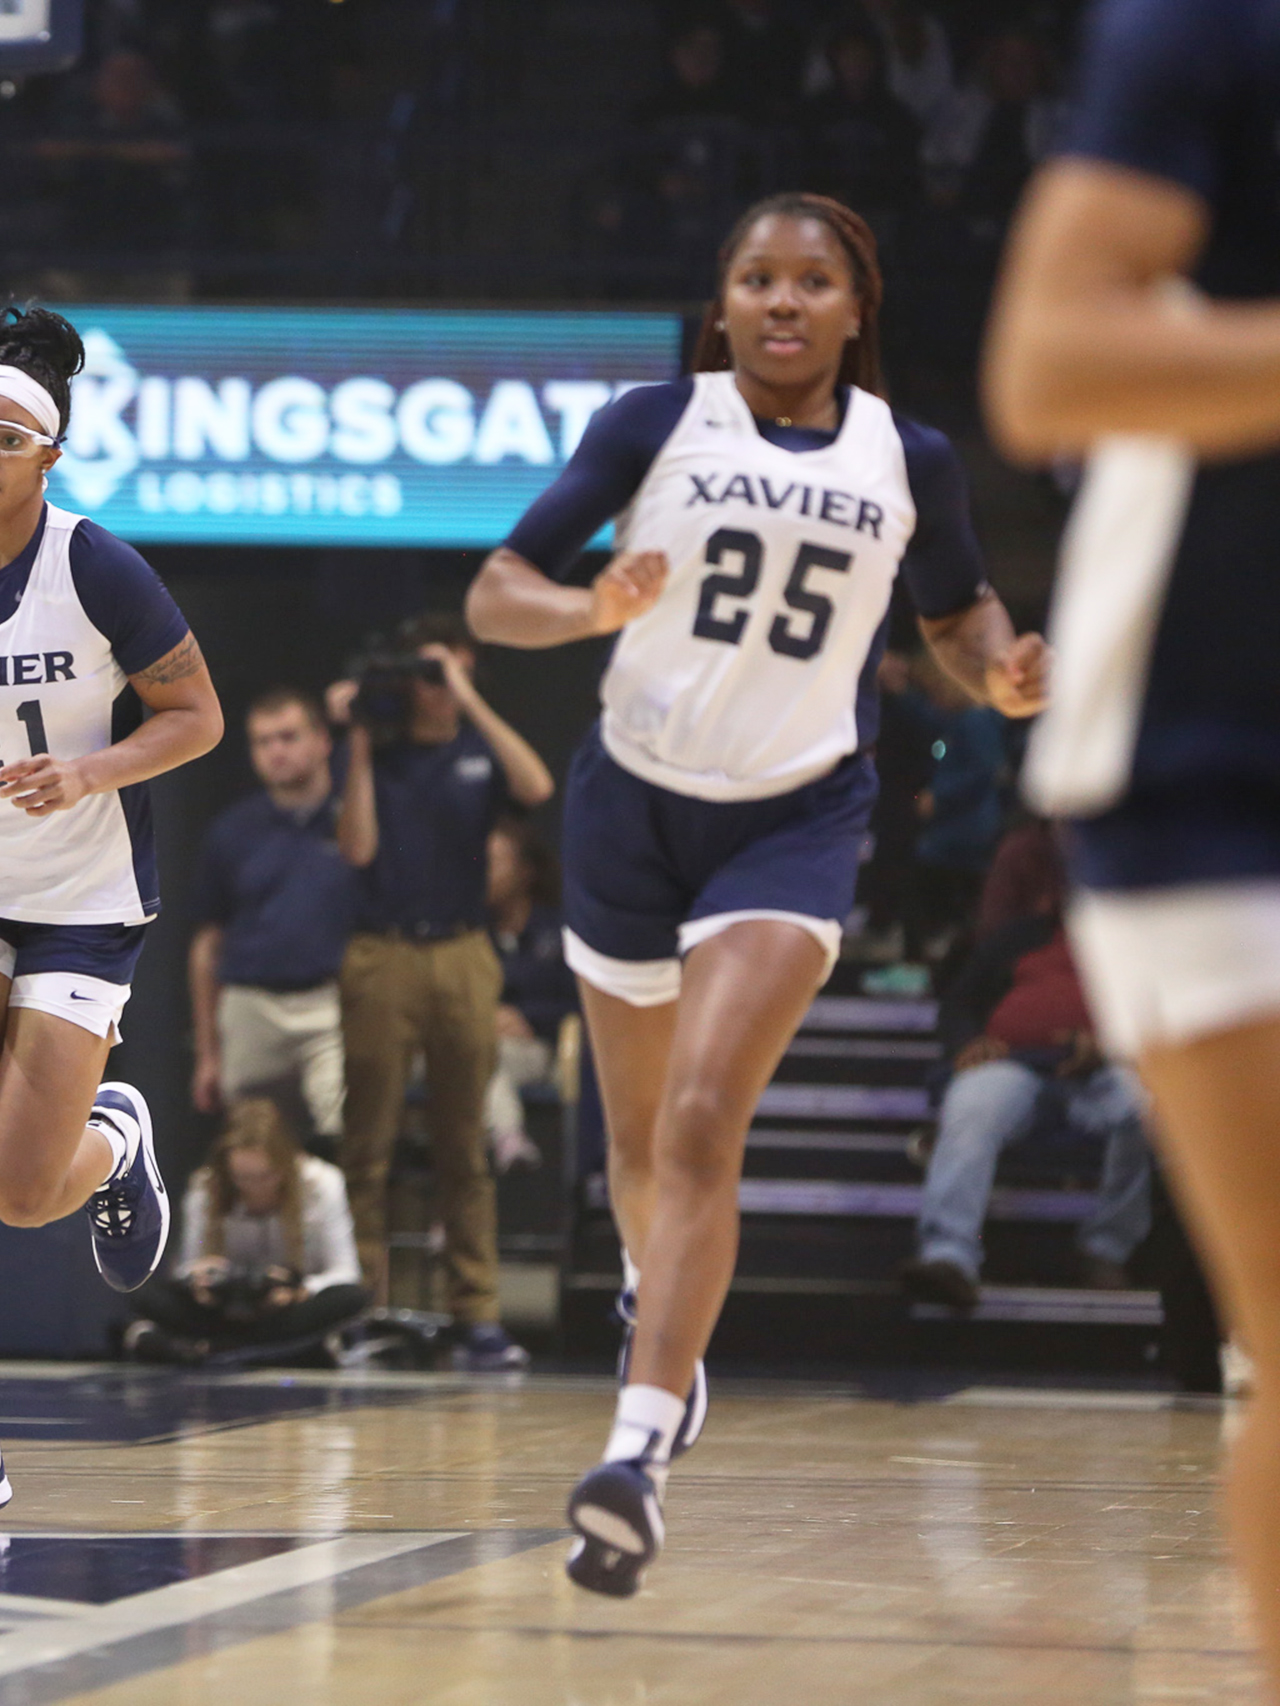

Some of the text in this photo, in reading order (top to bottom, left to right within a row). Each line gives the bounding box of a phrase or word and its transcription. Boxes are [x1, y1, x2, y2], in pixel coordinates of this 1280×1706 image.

[67, 374, 672, 466] KINGSGAT
[136, 471, 404, 518] LOGISTICS
[683, 471, 886, 542] XAVIER
[691, 525, 854, 663] 25
